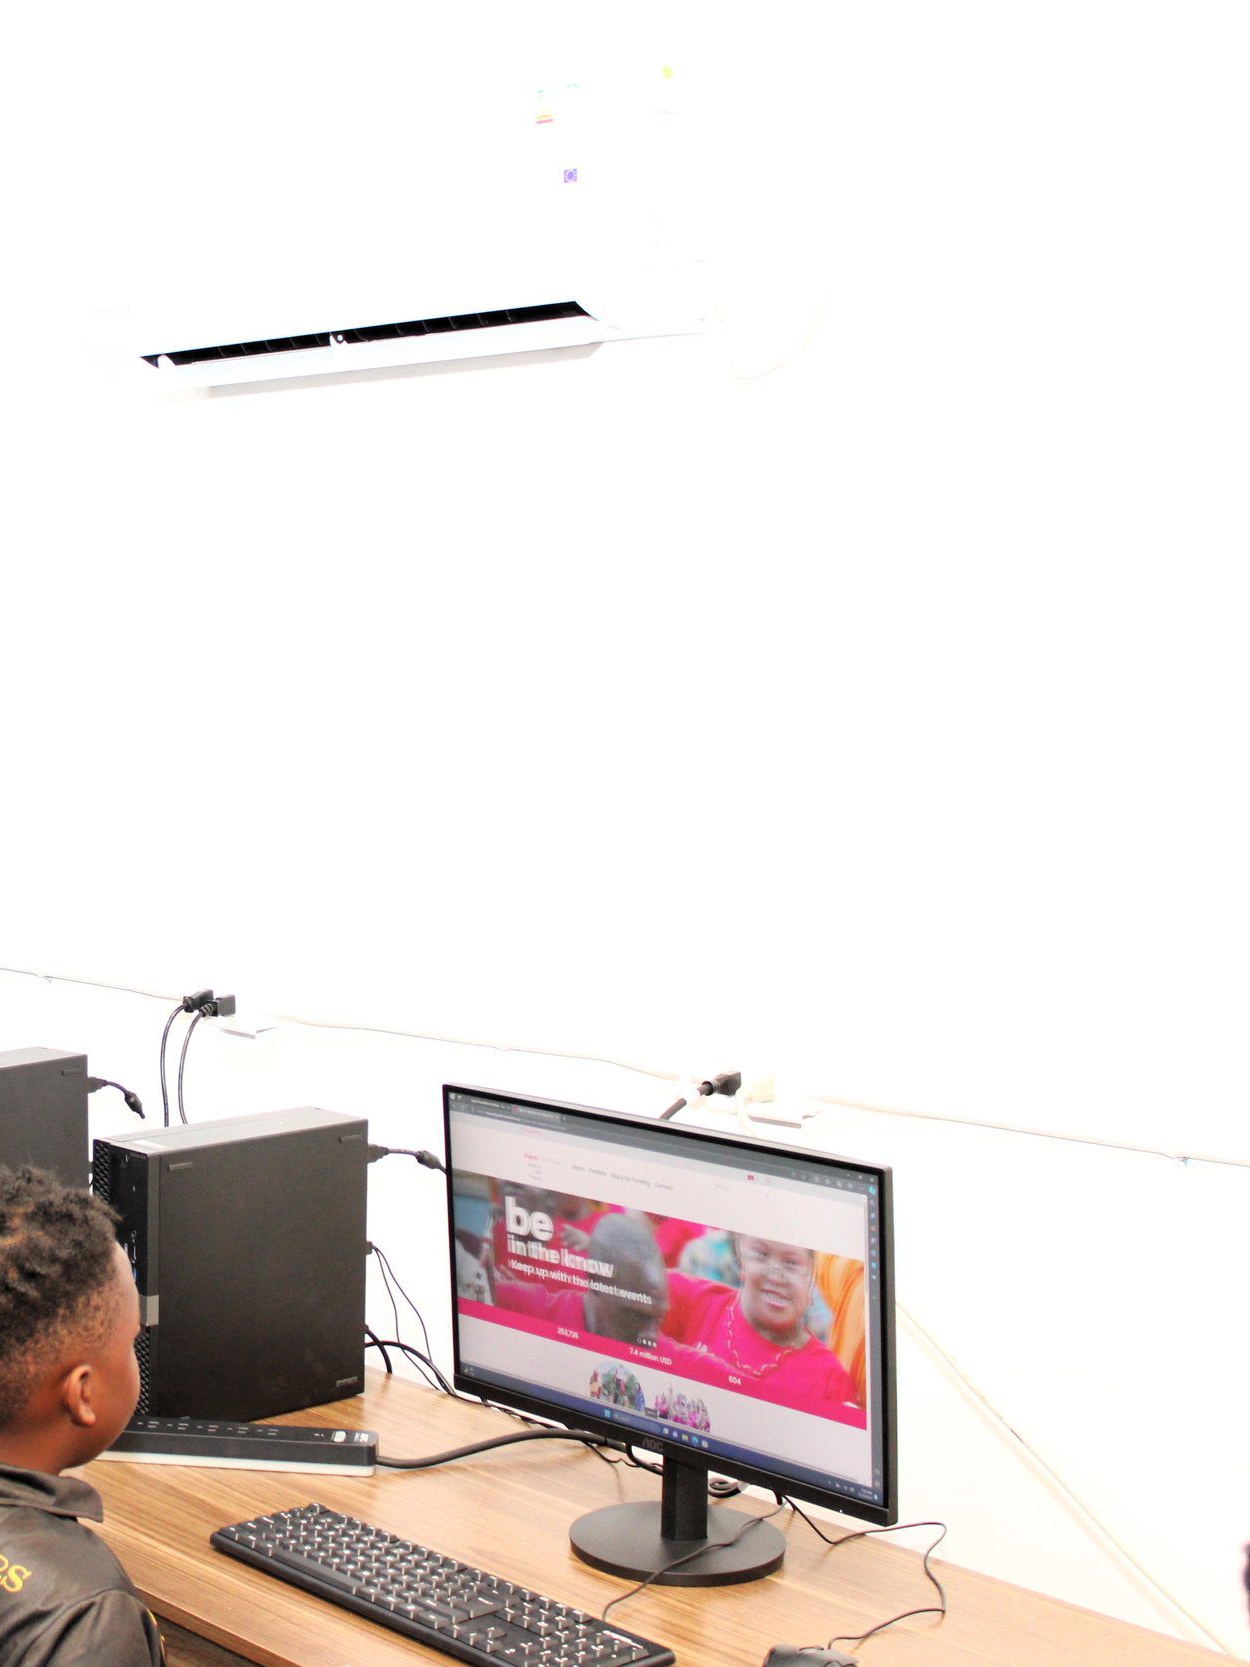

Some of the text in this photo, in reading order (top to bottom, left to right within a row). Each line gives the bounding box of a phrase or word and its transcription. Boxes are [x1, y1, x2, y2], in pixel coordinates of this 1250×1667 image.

[505, 1196, 554, 1242] be
[507, 1234, 615, 1278] in the know
[509, 1259, 536, 1276] Keep
[537, 1268, 549, 1281] up
[551, 1270, 572, 1284] with
[572, 1273, 588, 1288] the
